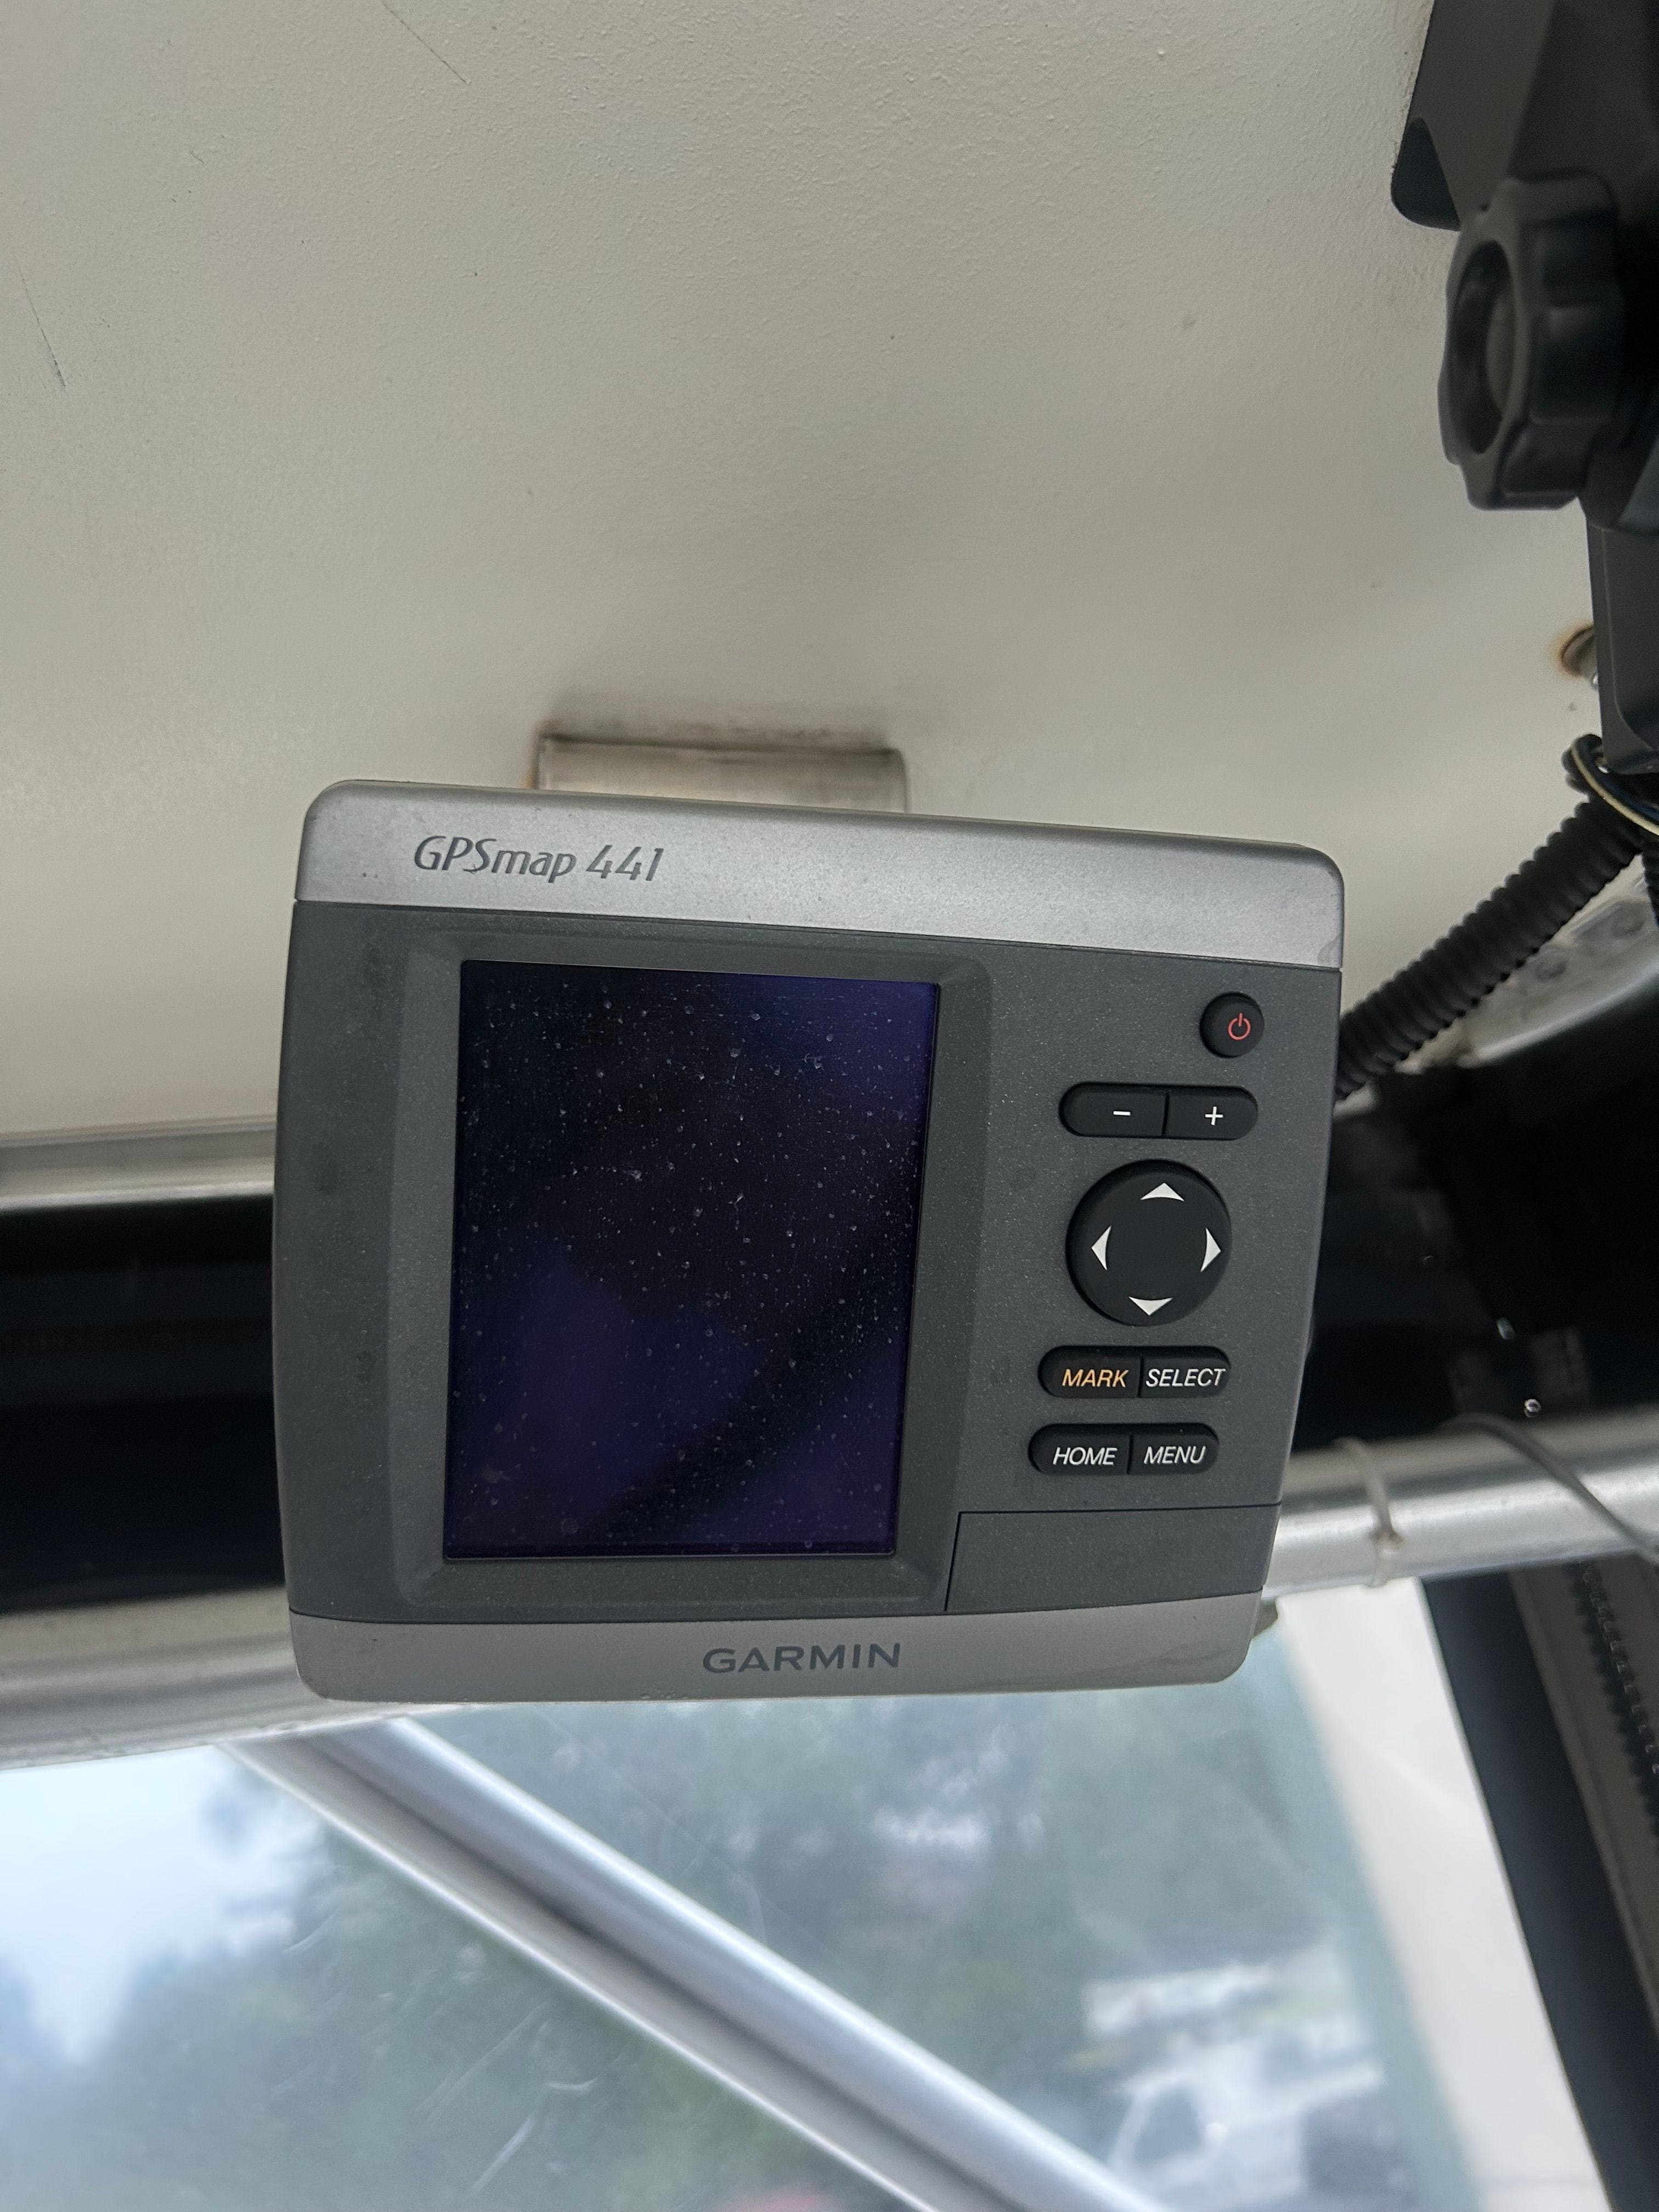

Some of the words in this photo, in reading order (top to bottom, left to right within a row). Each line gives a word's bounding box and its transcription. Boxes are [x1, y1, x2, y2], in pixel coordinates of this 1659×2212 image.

[414, 835, 577, 883] GPSmap
[585, 844, 664, 882] 441
[1062, 1368, 1129, 1388] MARK
[1146, 1368, 1227, 1388] SELECT
[1052, 1446, 1118, 1466] HOME
[1143, 1445, 1206, 1465] MENU
[702, 1642, 901, 1673] GARMIN
